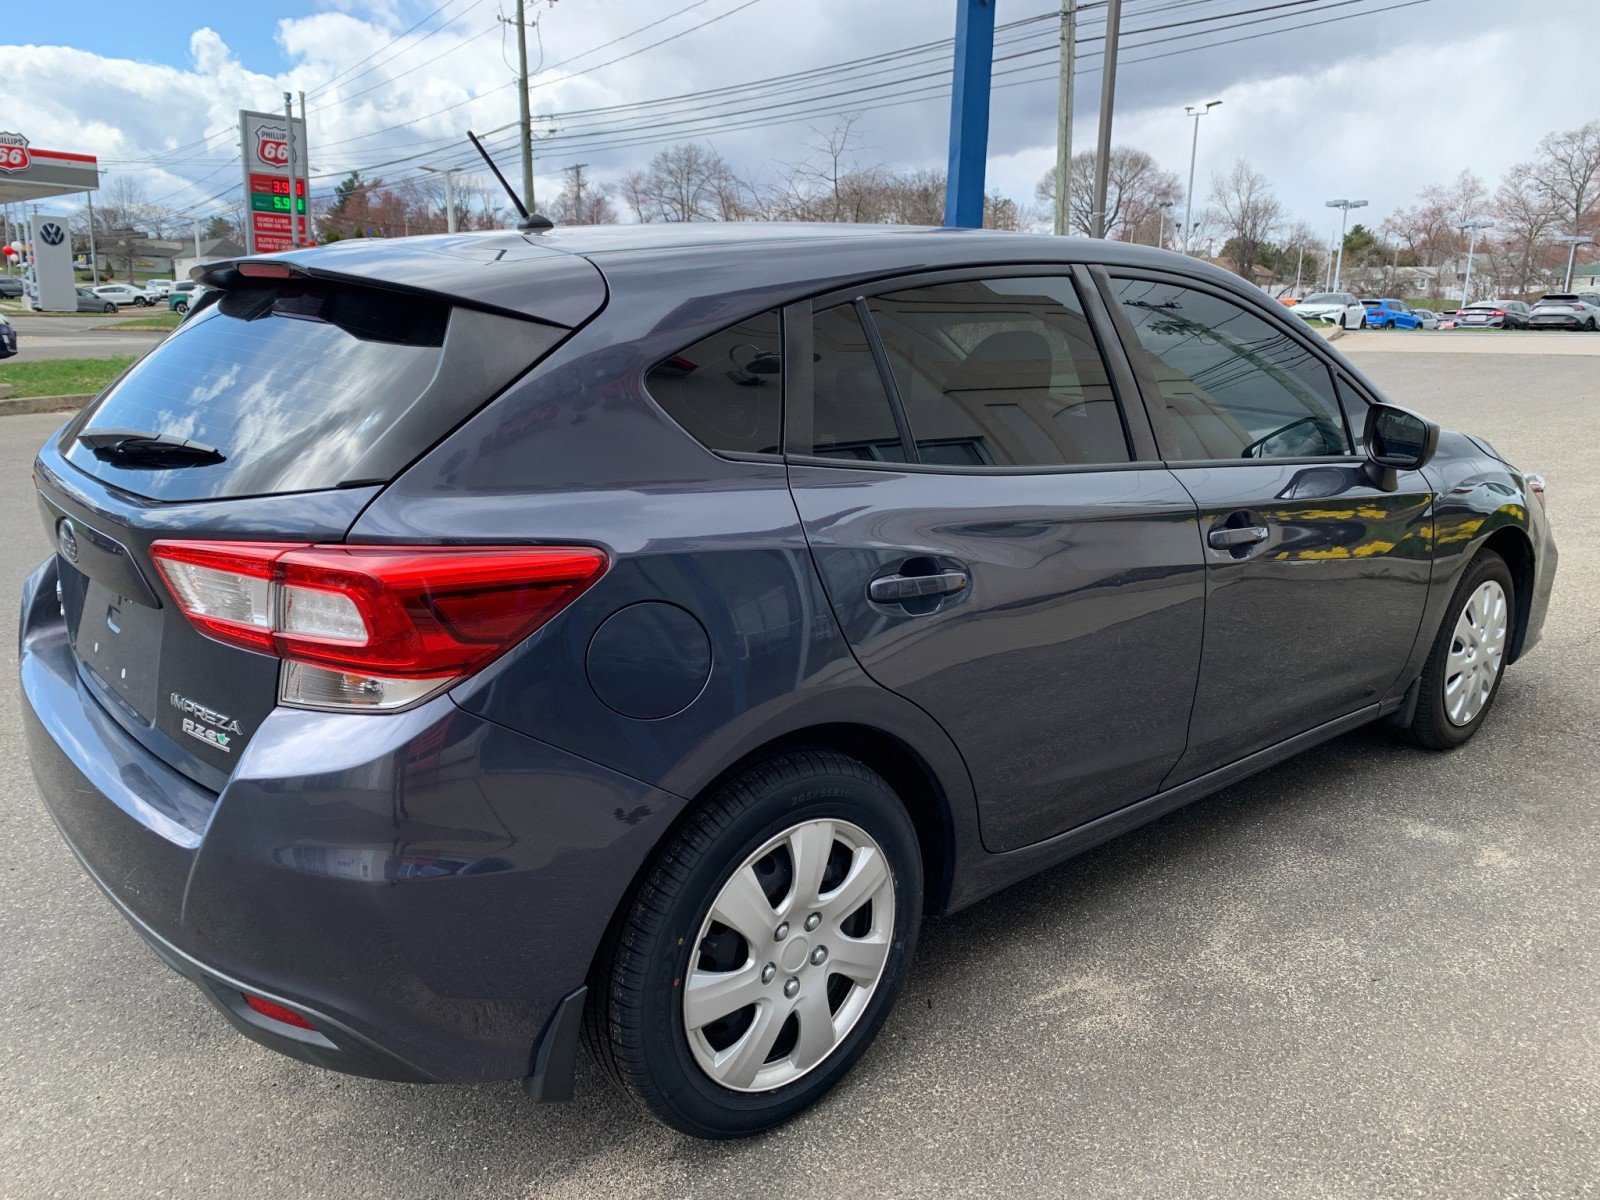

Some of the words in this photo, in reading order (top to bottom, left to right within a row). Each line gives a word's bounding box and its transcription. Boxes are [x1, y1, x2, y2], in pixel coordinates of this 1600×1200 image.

[0, 137, 23, 145] ILLIPS
[261, 131, 288, 140] PHILLIP
[264, 143, 288, 160] 66
[170, 692, 244, 736] IMPREZA
